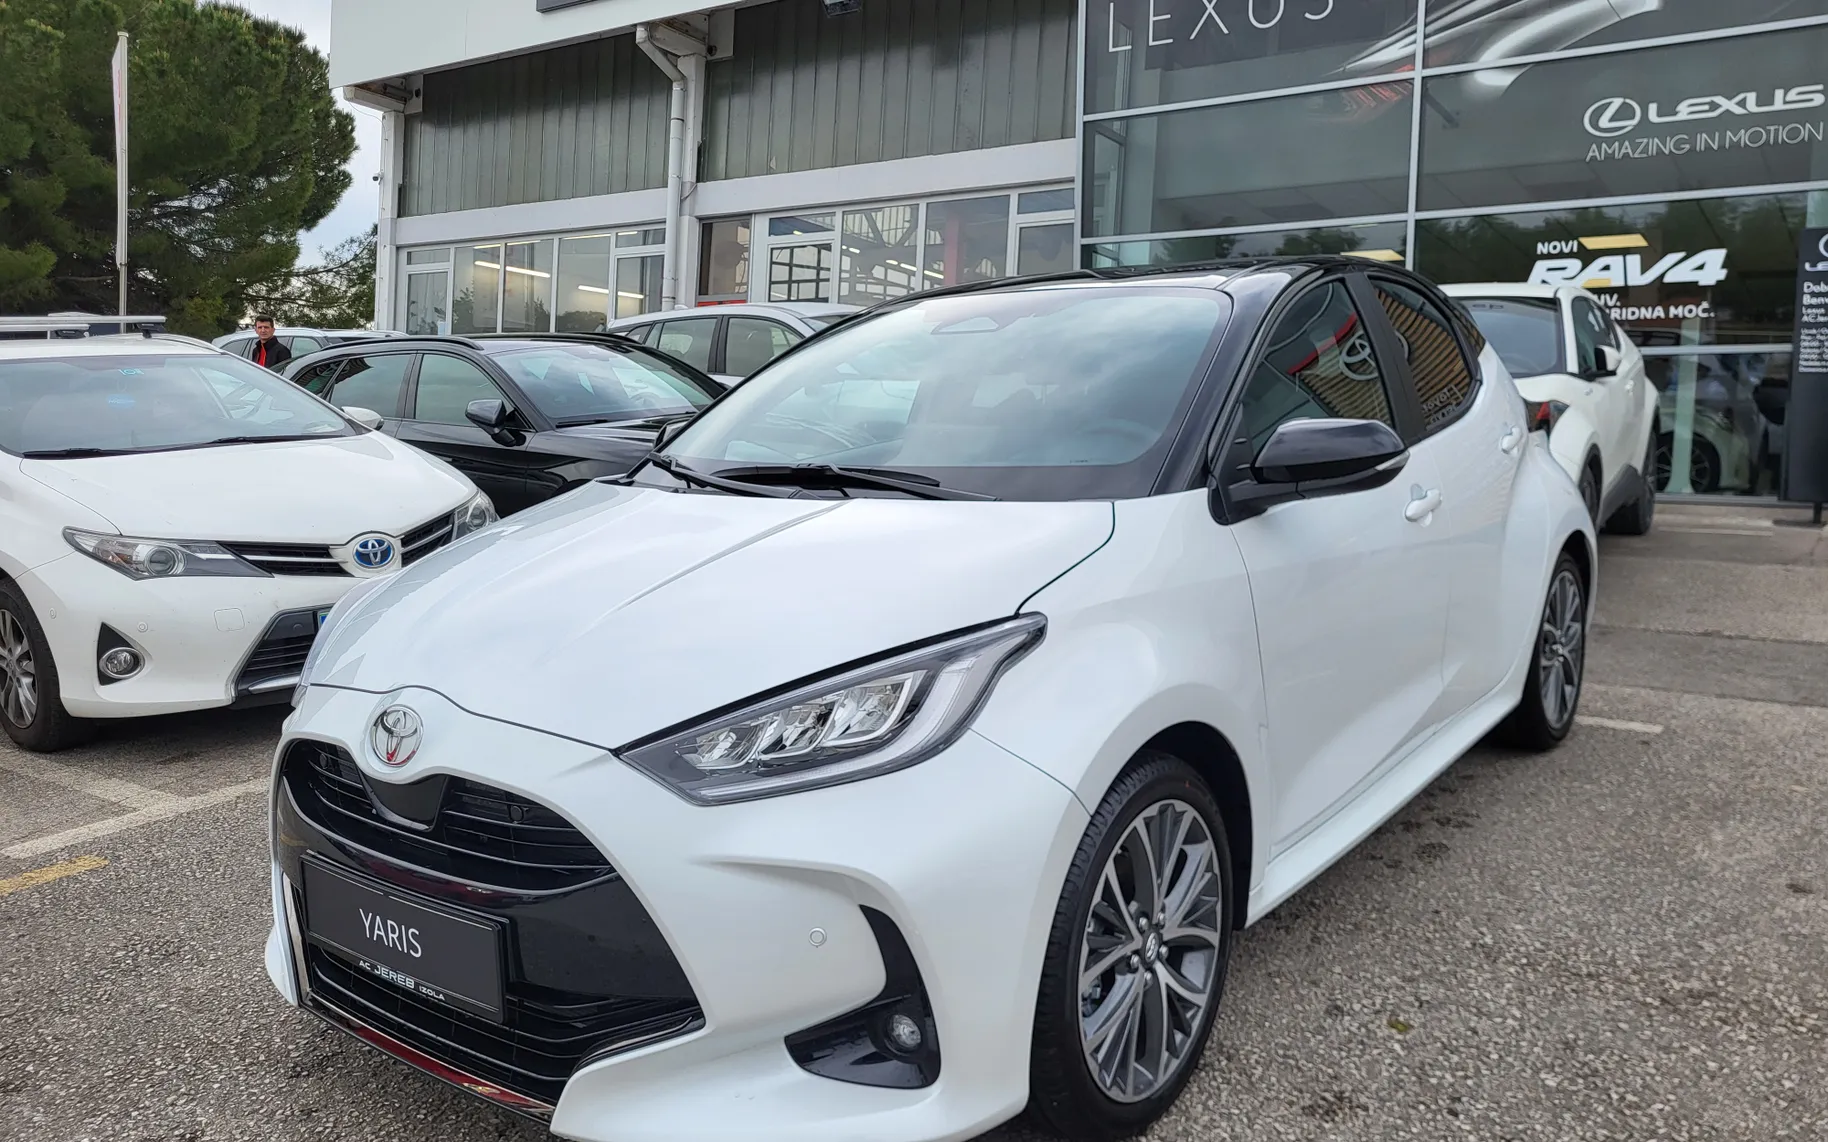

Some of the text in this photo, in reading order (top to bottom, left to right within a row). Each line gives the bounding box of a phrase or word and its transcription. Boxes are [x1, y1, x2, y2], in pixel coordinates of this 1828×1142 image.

[1648, 84, 1826, 123] LEXUS
[1585, 121, 1824, 163] AMAZING IN MOTION
[1536, 240, 1578, 255] NOVI
[1527, 248, 1728, 288] RAV4
[1594, 293, 1621, 306] UV.
[1605, 301, 1715, 321] RIDNA MOČ.
[359, 908, 422, 958] YARIS
[359, 960, 446, 1001] AC JEREB IZOLA
